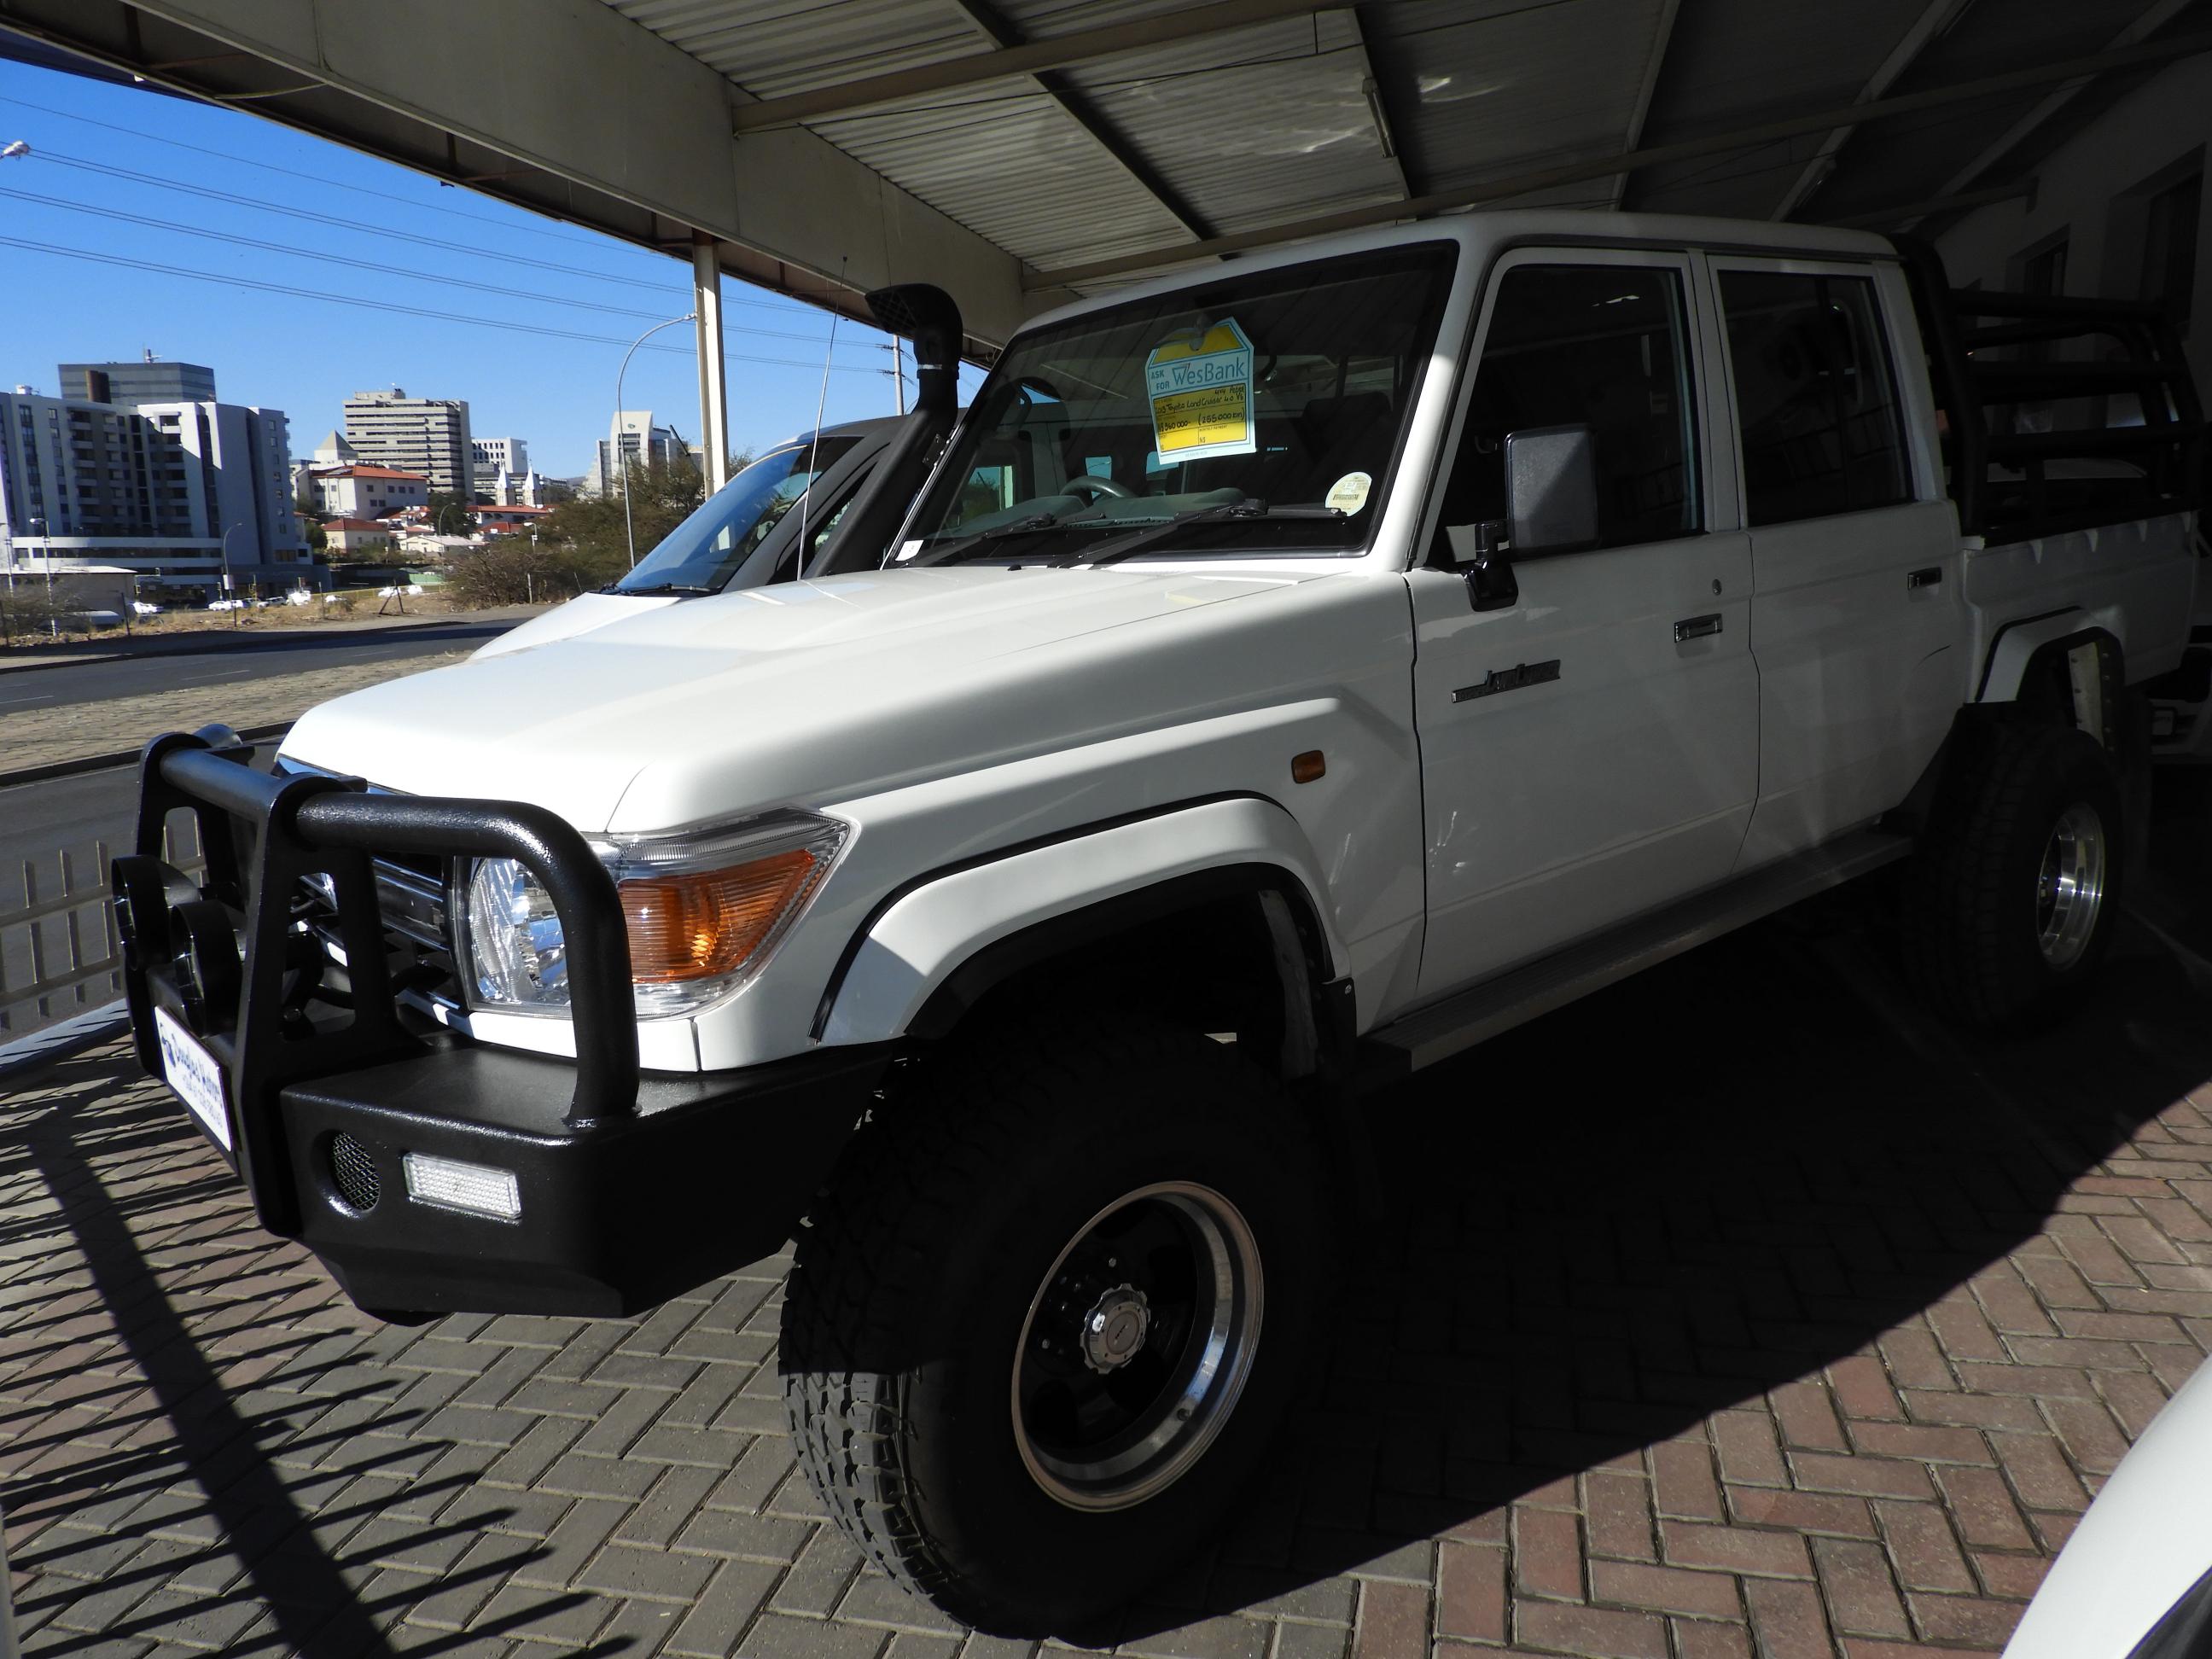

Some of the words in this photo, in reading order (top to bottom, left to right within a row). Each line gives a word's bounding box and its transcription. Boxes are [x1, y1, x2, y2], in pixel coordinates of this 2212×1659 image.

[1151, 370, 1165, 380] ASK
[1172, 357, 1245, 386] WesBank
[1155, 381, 1170, 391] FOR
